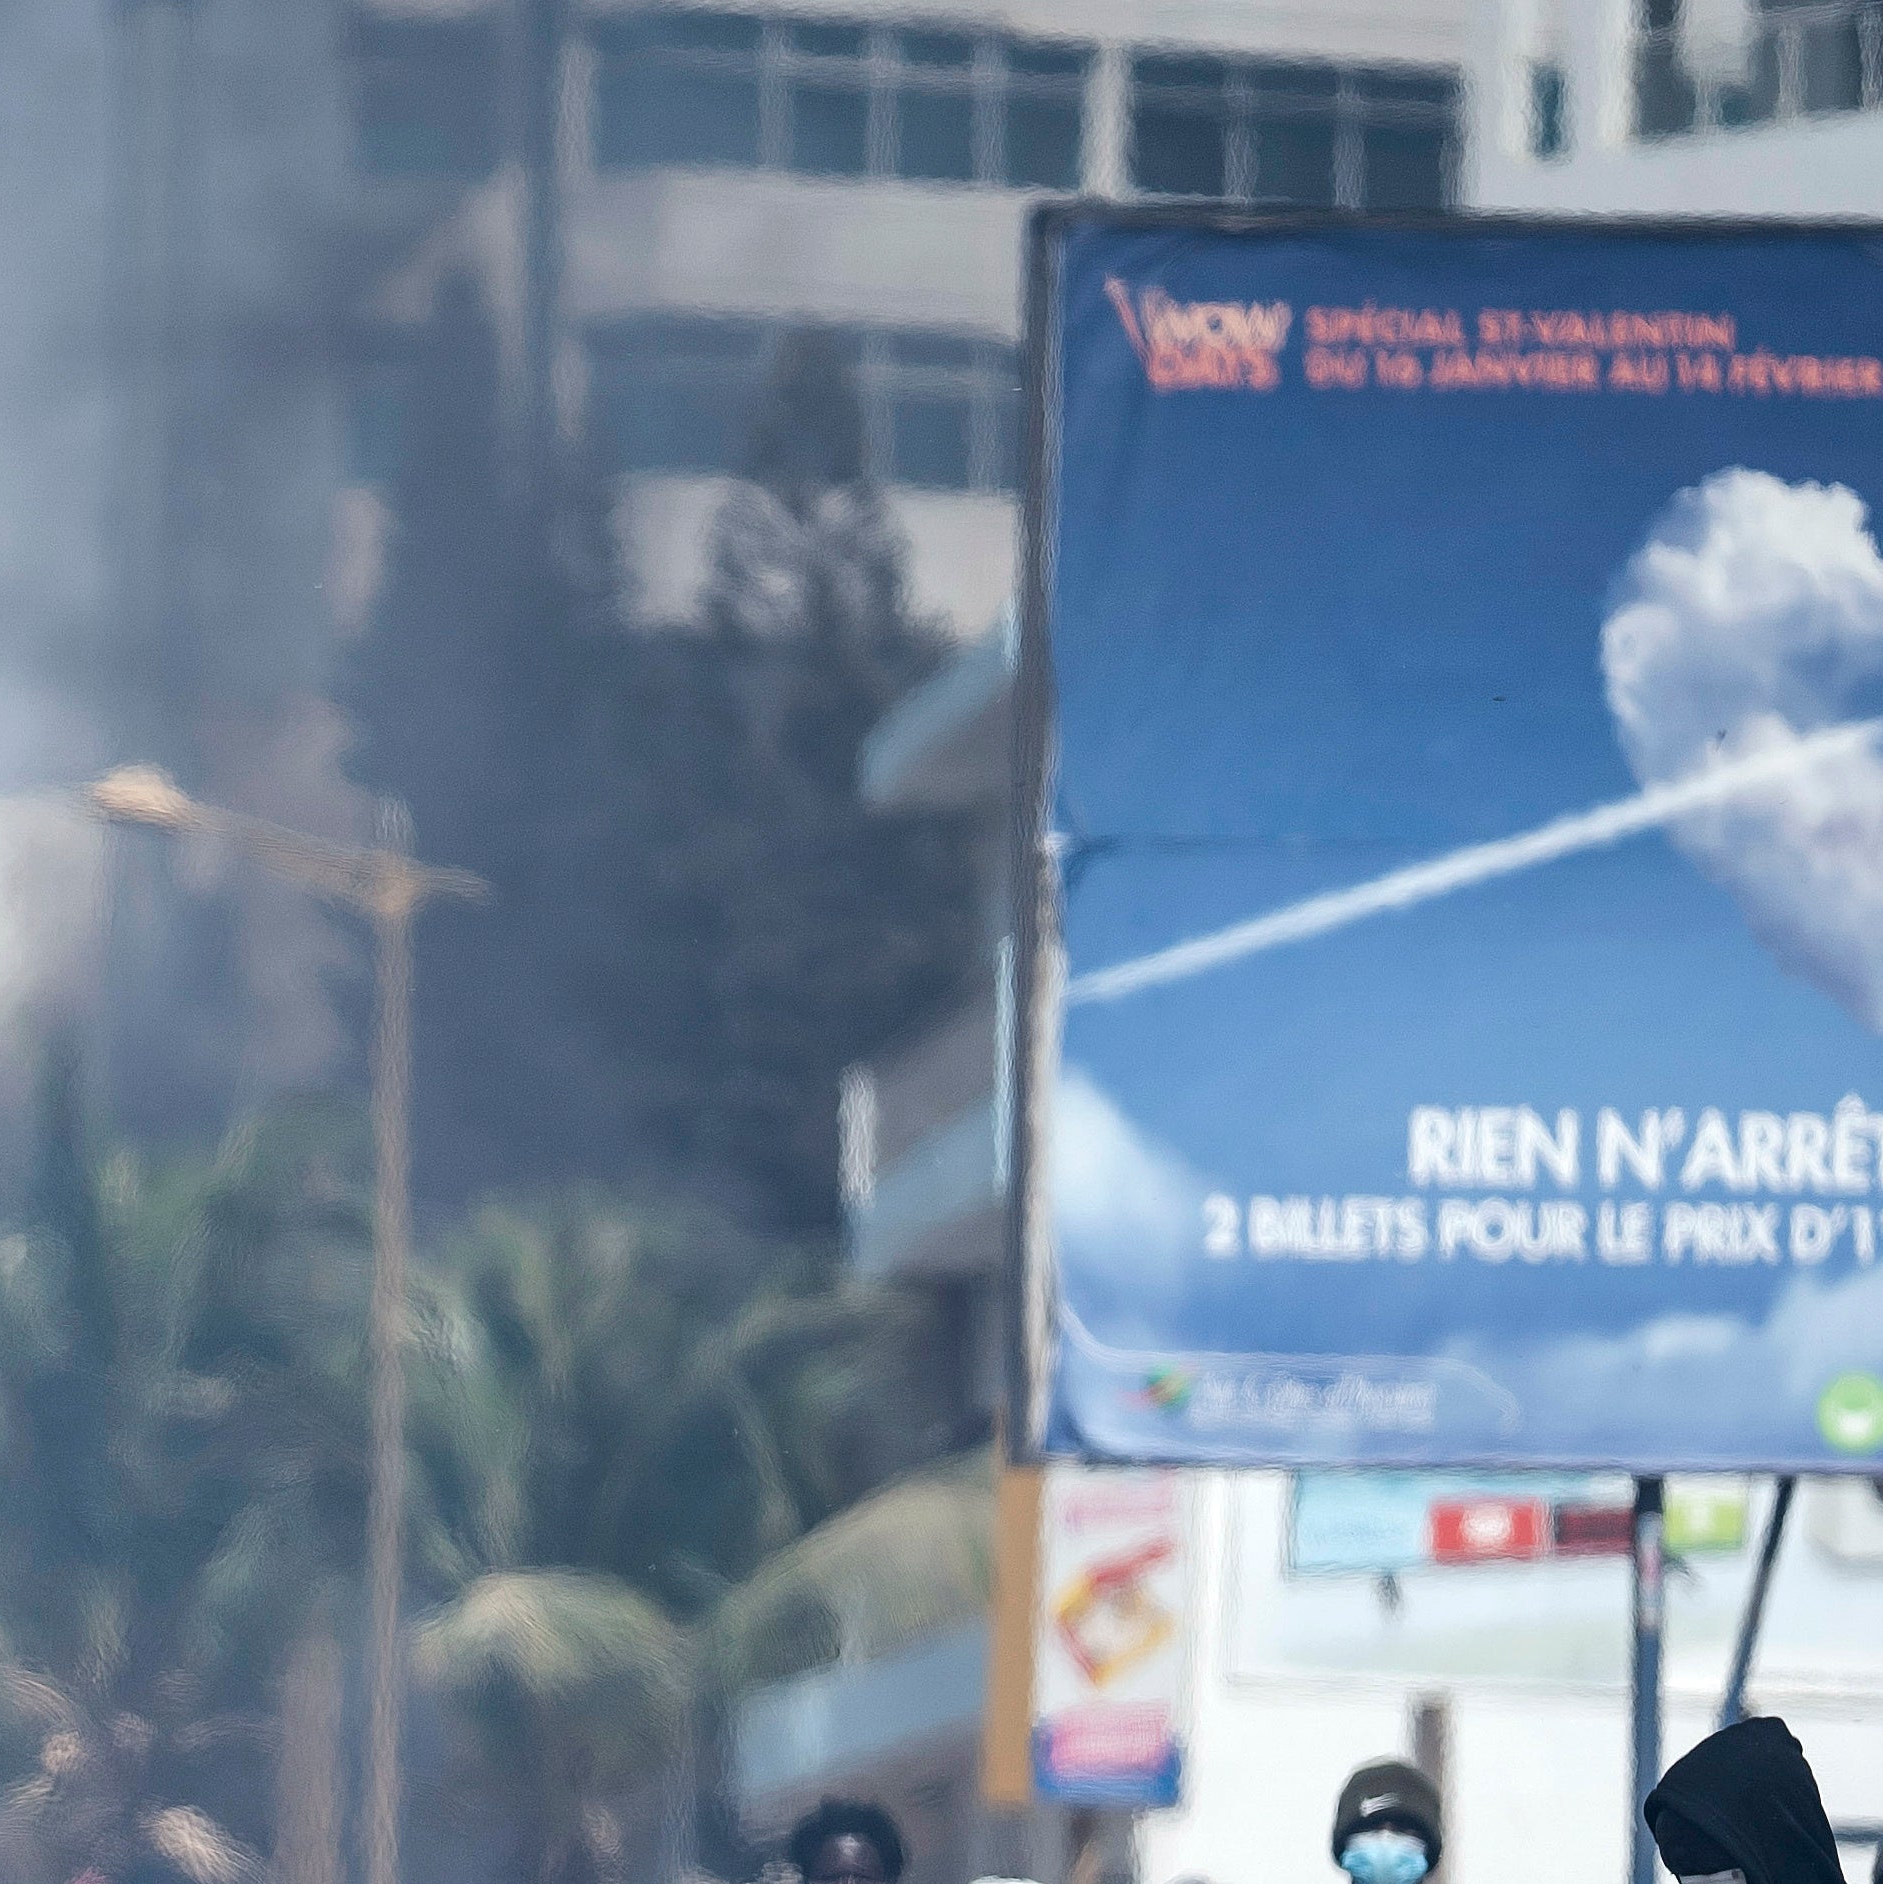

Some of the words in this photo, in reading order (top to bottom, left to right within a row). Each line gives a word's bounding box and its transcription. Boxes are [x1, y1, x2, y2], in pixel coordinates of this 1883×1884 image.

[1305, 298, 1463, 346] SPÉCIAL
[1478, 308, 1735, 350] ST-VALENTIN
[1305, 347, 1368, 390] DU
[1429, 350, 1598, 392] JANVIER
[1607, 352, 1669, 395] AU
[1730, 344, 1883, 398] FÉVRIER
[1407, 1104, 1579, 1189] RIEN
[1204, 1193, 1240, 1259] 2
[1247, 1194, 1429, 1264] BILLETS
[1437, 1197, 1588, 1265] POUR
[1596, 1200, 1652, 1266] LE
[1661, 1200, 1781, 1266] PRIX
